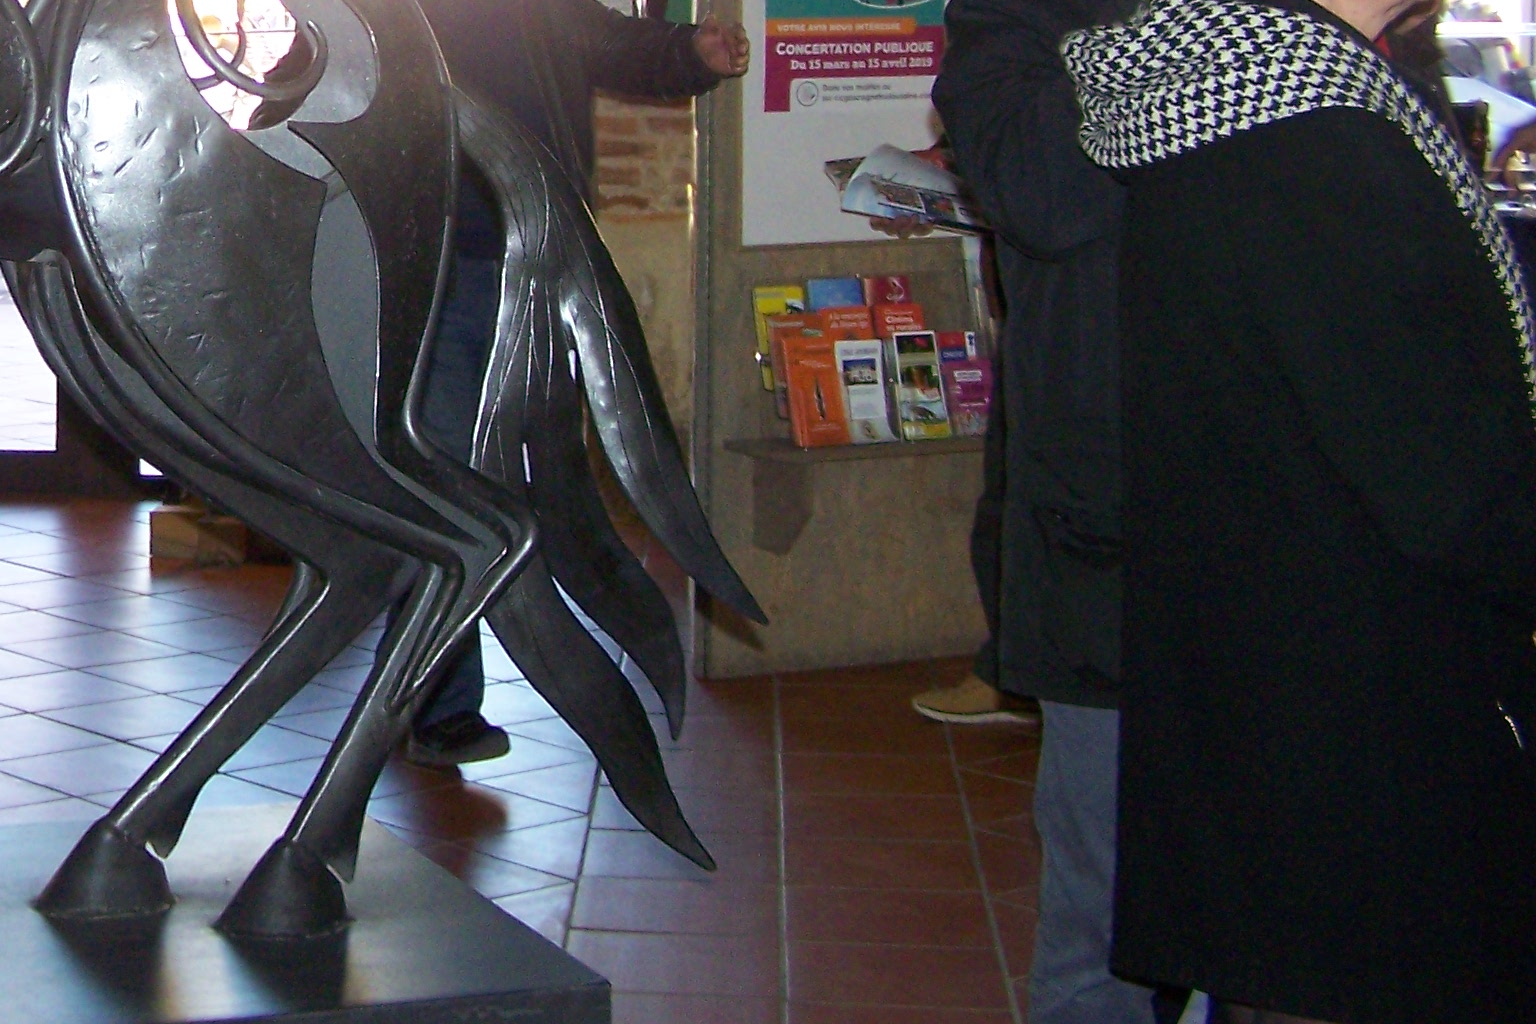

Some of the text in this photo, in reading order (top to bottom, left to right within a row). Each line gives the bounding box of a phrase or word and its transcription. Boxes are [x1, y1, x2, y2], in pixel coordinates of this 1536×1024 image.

[776, 41, 934, 55] CONCERTATION PUBLIQUE
[790, 59, 806, 70] Du
[809, 59, 821, 69] 15
[822, 61, 850, 69] mars
[852, 60, 866, 69] au
[868, 58, 880, 68] 15
[881, 57, 907, 68] avril
